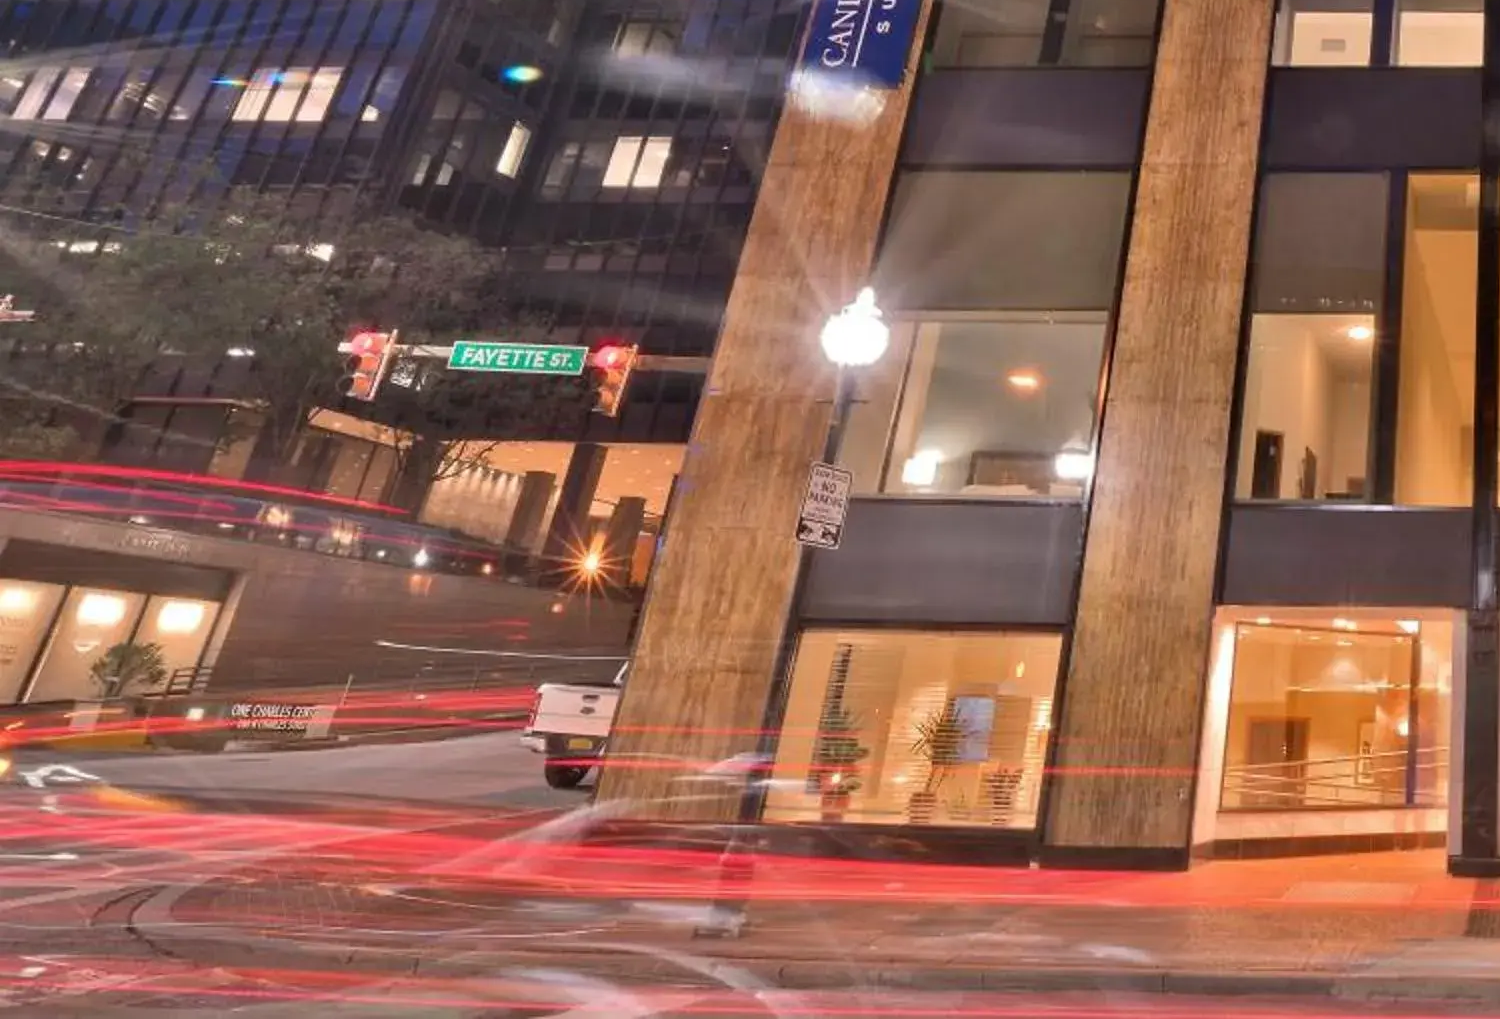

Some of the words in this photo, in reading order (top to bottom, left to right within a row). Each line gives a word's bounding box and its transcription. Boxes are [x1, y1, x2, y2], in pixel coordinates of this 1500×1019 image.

[459, 347, 549, 368] FAYETTE
[549, 352, 574, 368] ST.
[821, 481, 837, 494] NO
